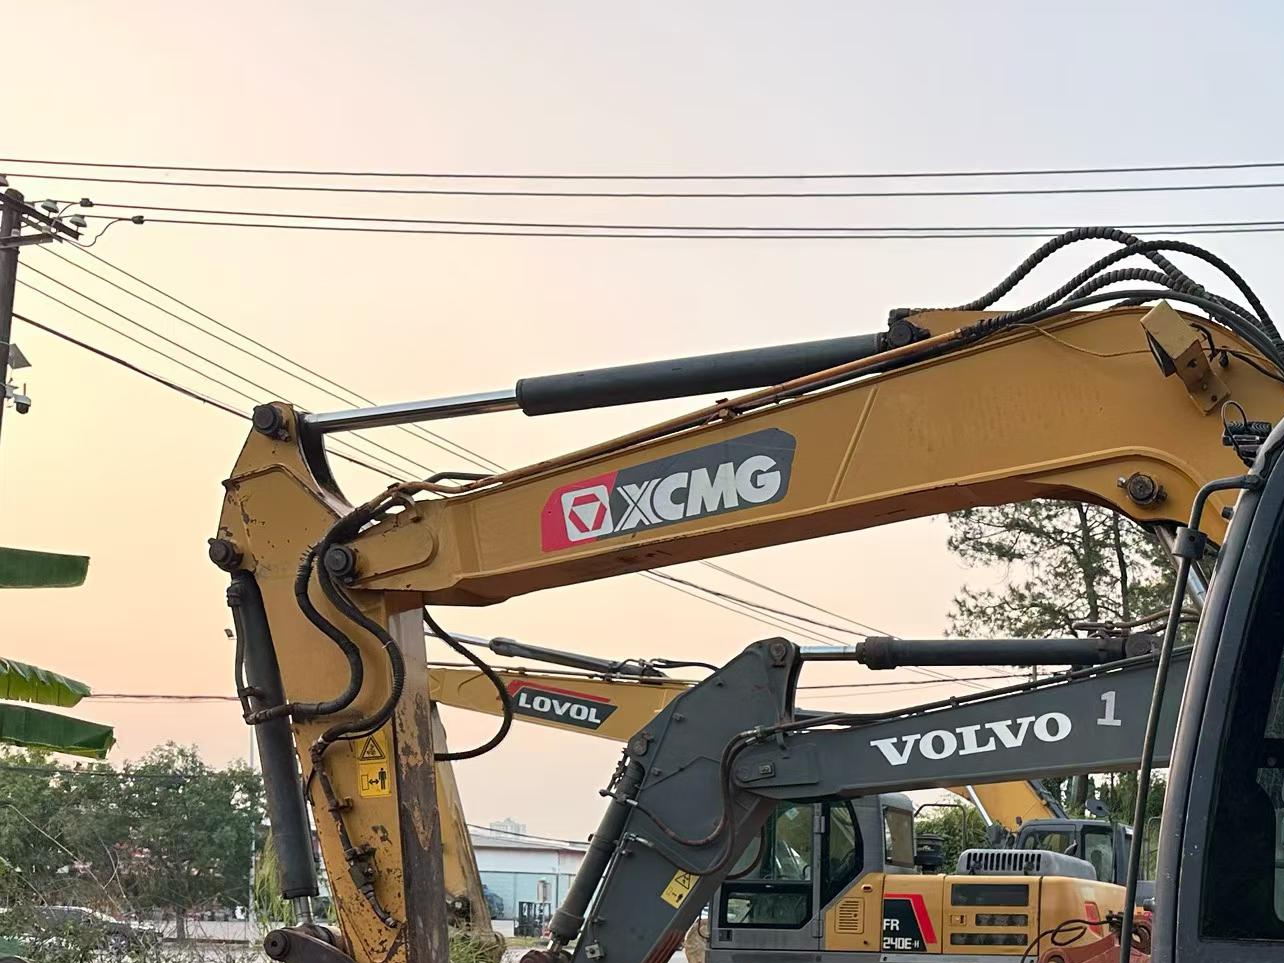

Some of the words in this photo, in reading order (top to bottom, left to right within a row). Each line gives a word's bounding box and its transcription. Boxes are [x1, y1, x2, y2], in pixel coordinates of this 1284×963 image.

[614, 455, 781, 532] XCMG
[518, 692, 600, 724] LOVOL
[870, 712, 1072, 766] VOLVO
[1097, 691, 1122, 726] 1
[883, 919, 899, 931] FR
